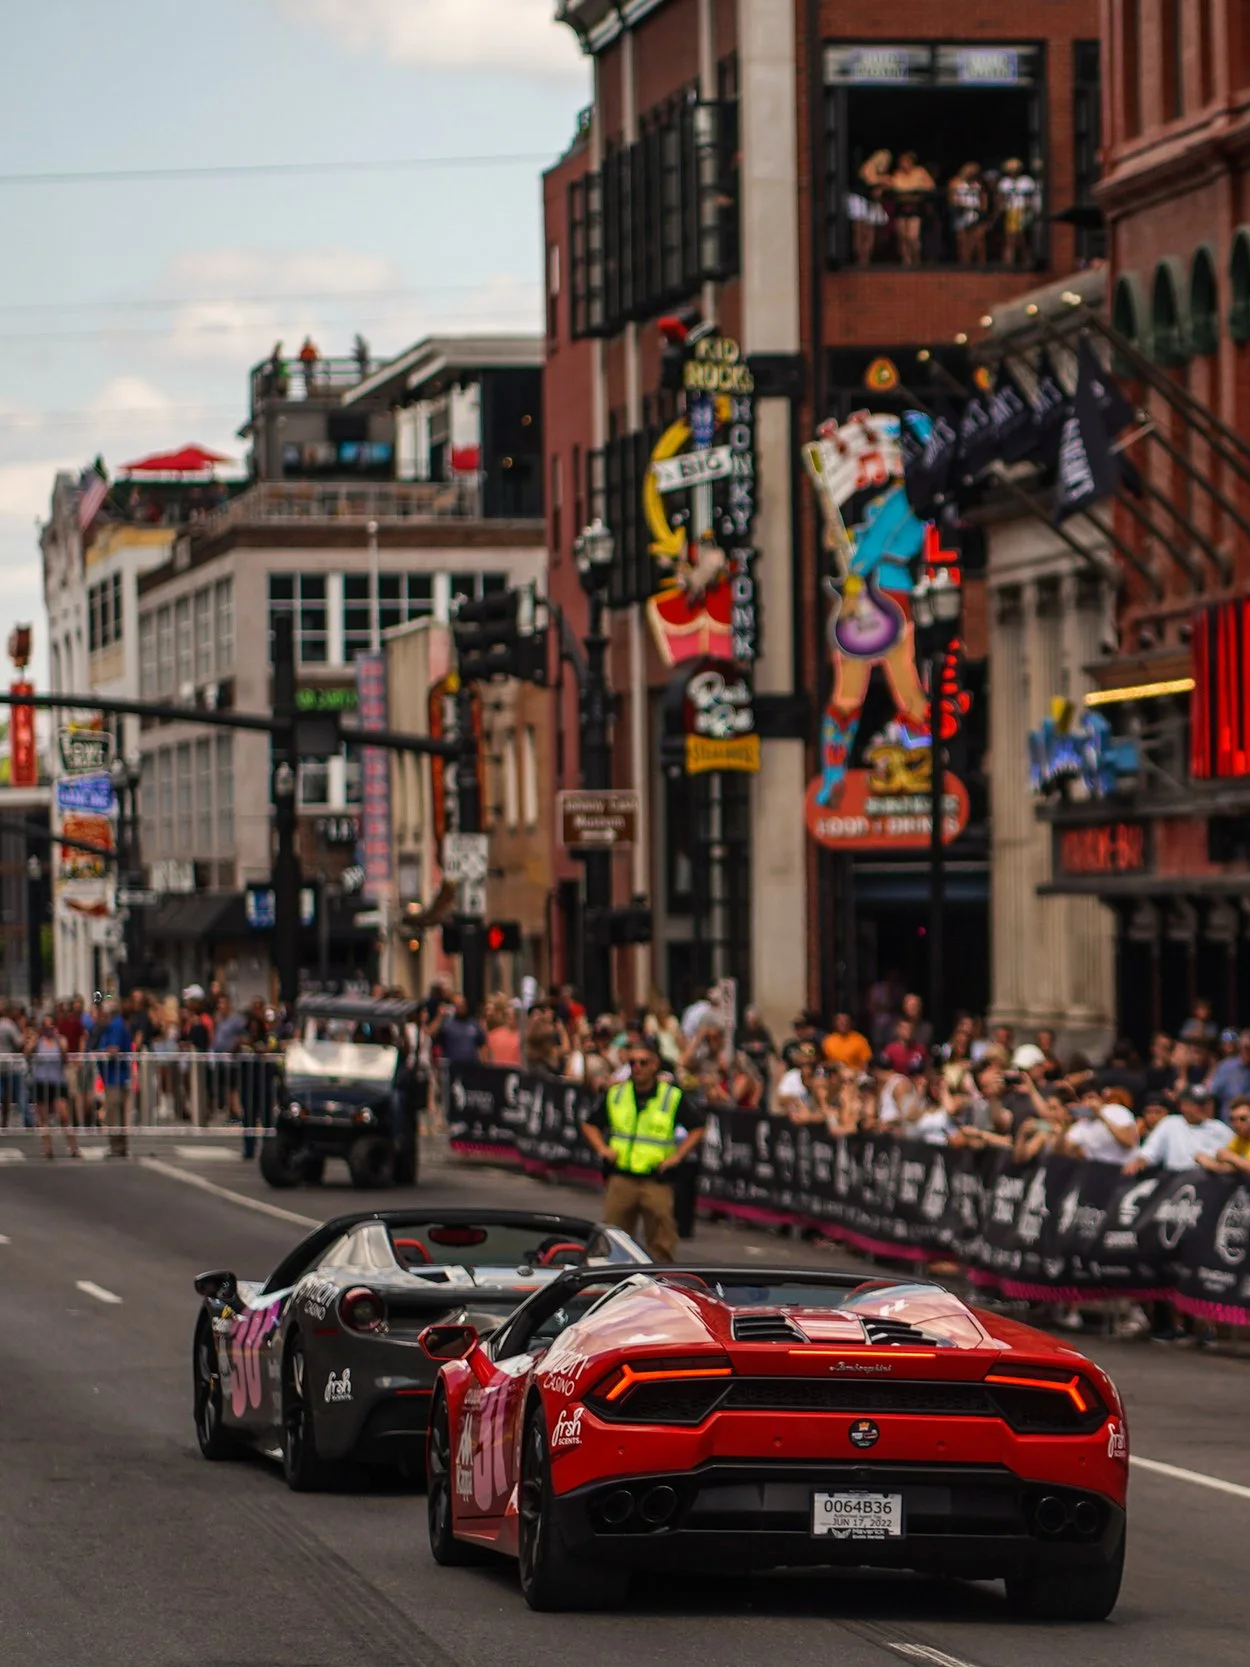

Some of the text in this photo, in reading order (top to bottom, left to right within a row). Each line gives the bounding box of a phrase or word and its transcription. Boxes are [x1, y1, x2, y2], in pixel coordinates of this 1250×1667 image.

[730, 396, 756, 664] HONKY TONK
[324, 1368, 352, 1403] frsh
[543, 1373, 575, 1397] CASINO
[552, 1407, 585, 1446] frsh
[824, 1500, 892, 1514] 0064B36
[832, 1518, 892, 1528] JUN 17, 2022
